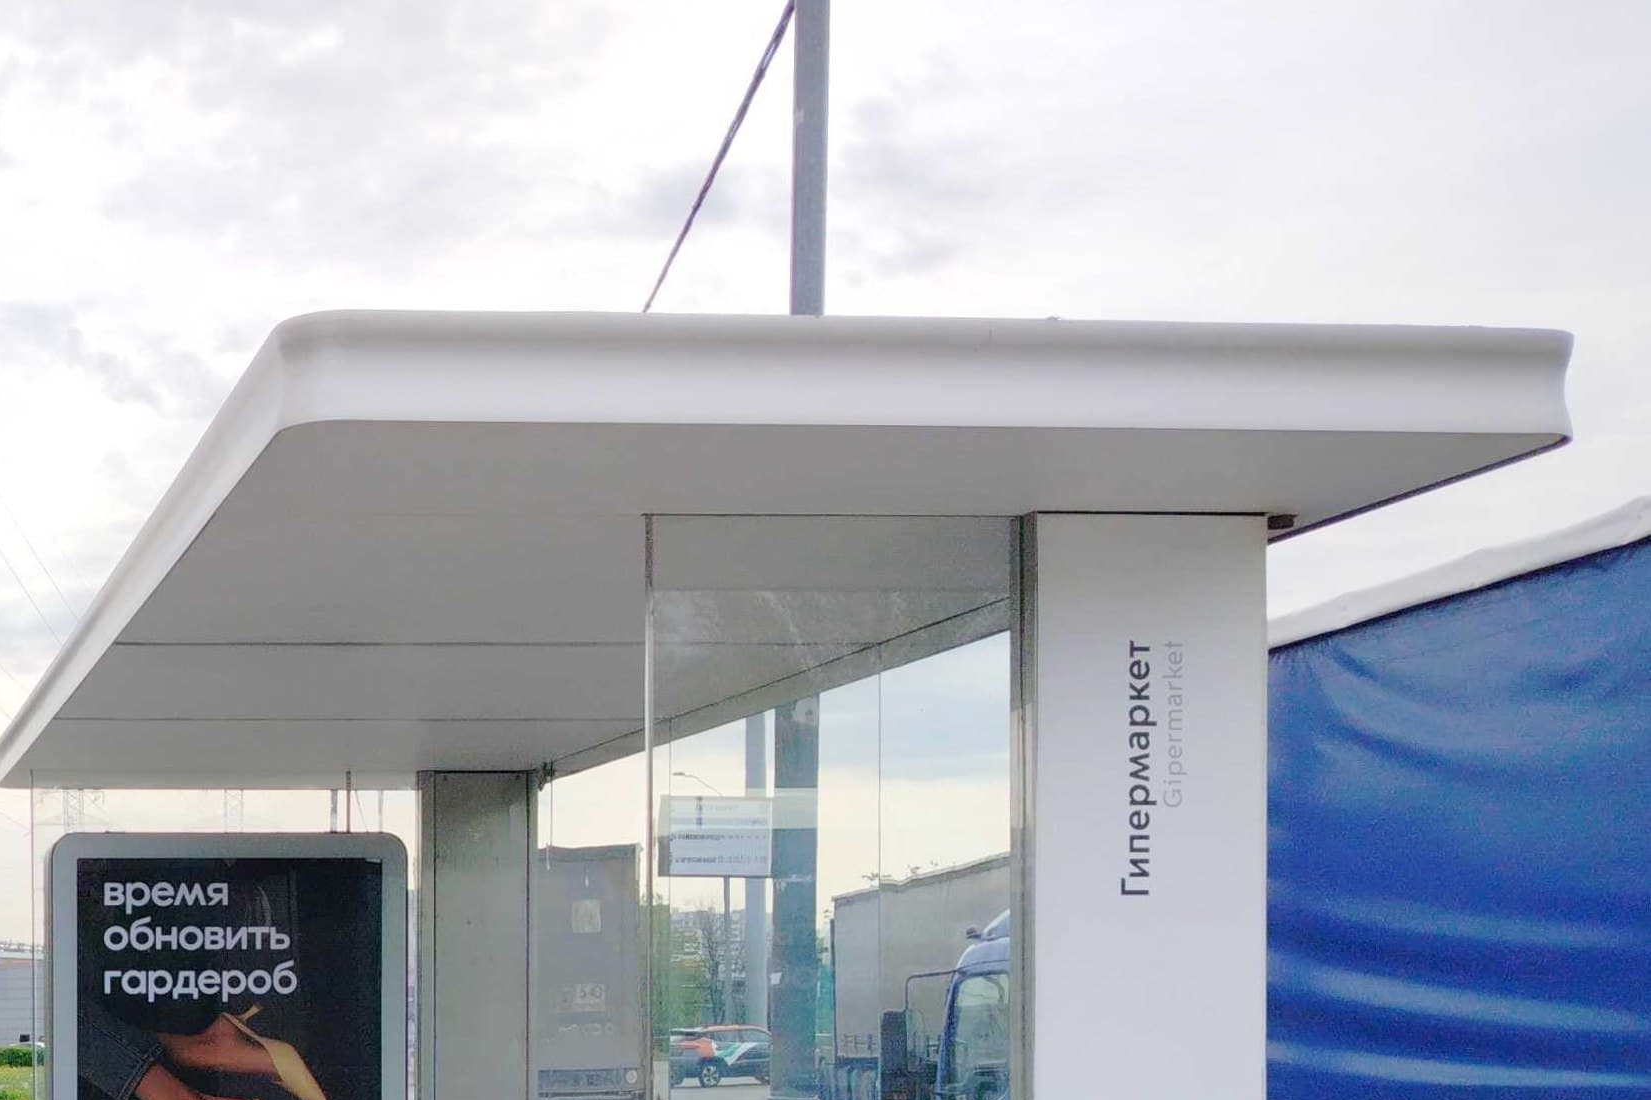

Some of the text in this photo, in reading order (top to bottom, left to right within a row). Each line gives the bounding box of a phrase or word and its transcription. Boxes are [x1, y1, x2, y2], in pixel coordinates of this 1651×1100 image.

[1162, 640, 1188, 808] Gipermarket
[1120, 639, 1158, 896] Гипермаркет
[103, 881, 229, 915] время
[103, 915, 291, 951] обновить
[103, 959, 298, 1003] гардероб
